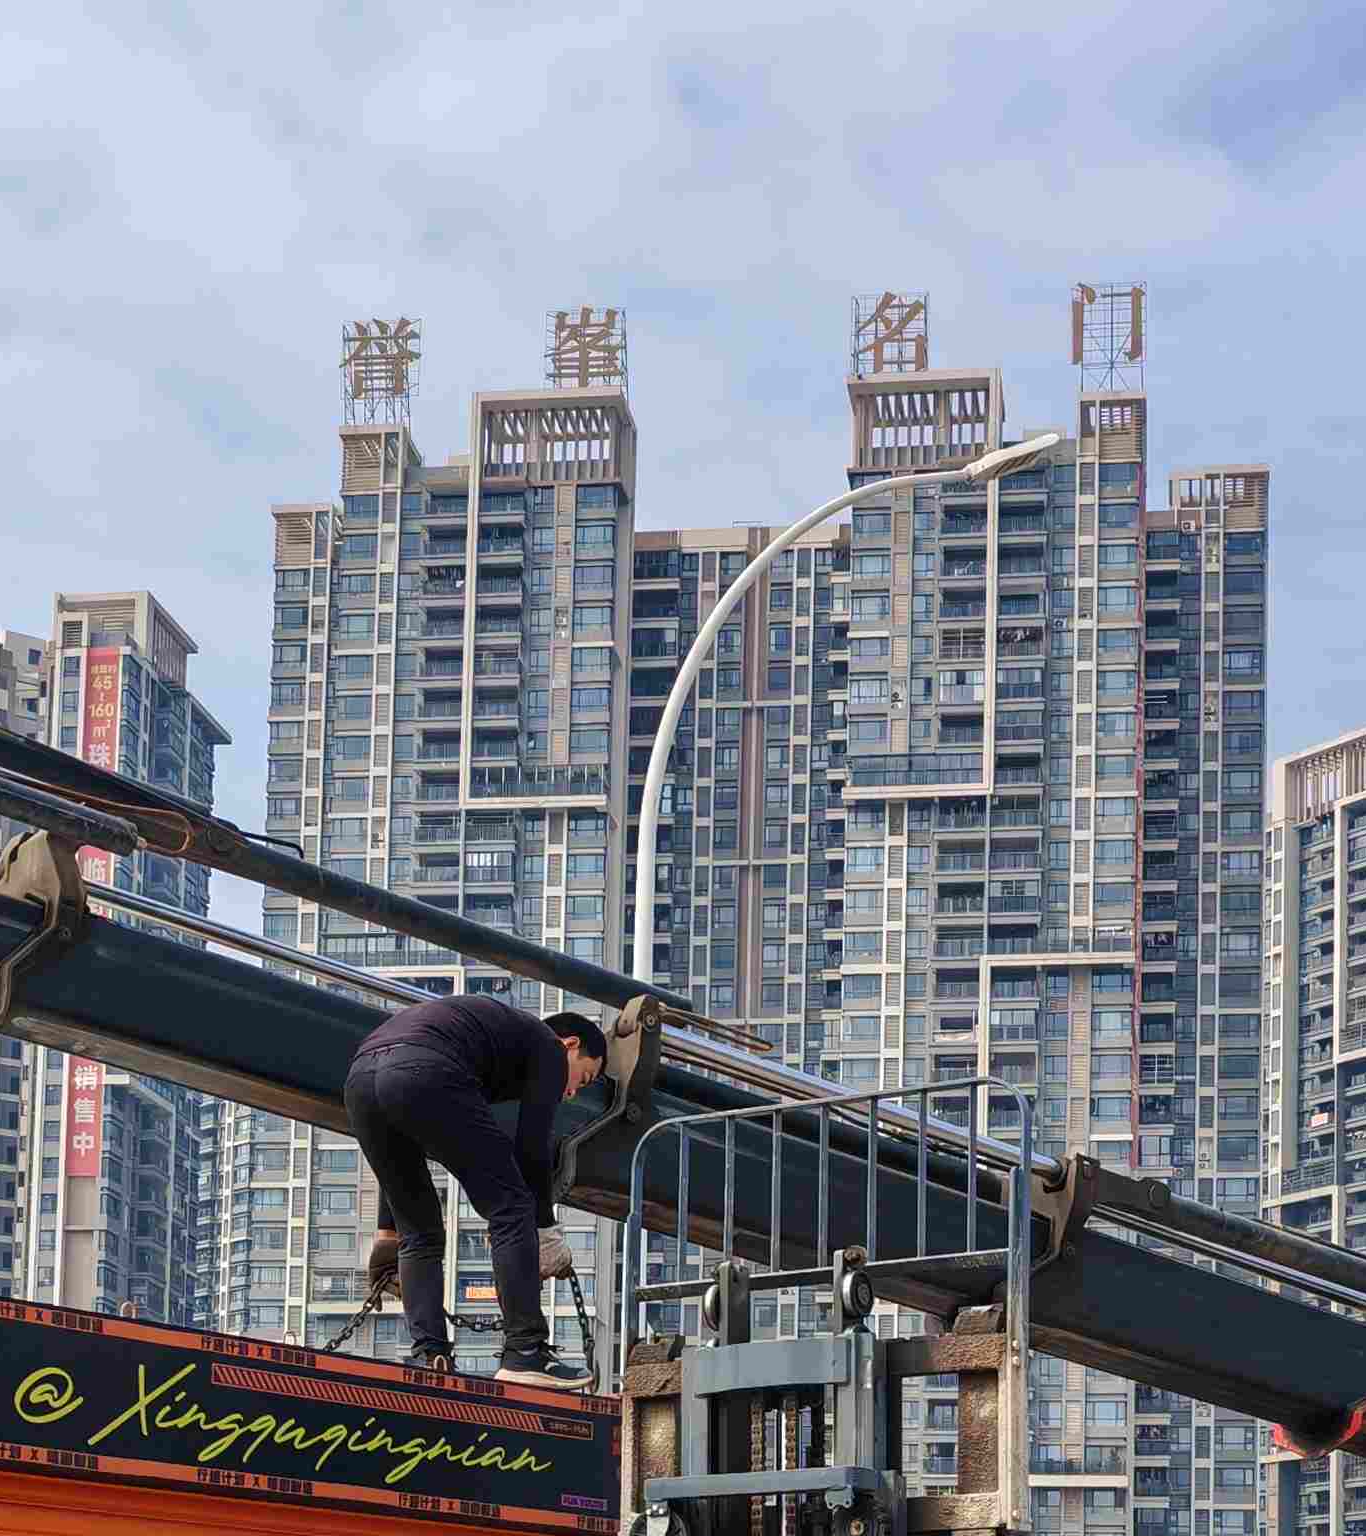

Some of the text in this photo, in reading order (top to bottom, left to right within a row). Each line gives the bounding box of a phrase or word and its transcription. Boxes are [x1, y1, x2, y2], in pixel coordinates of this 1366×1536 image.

[90, 703, 115, 718] 160
[73, 1065, 98, 1158] 销售中
